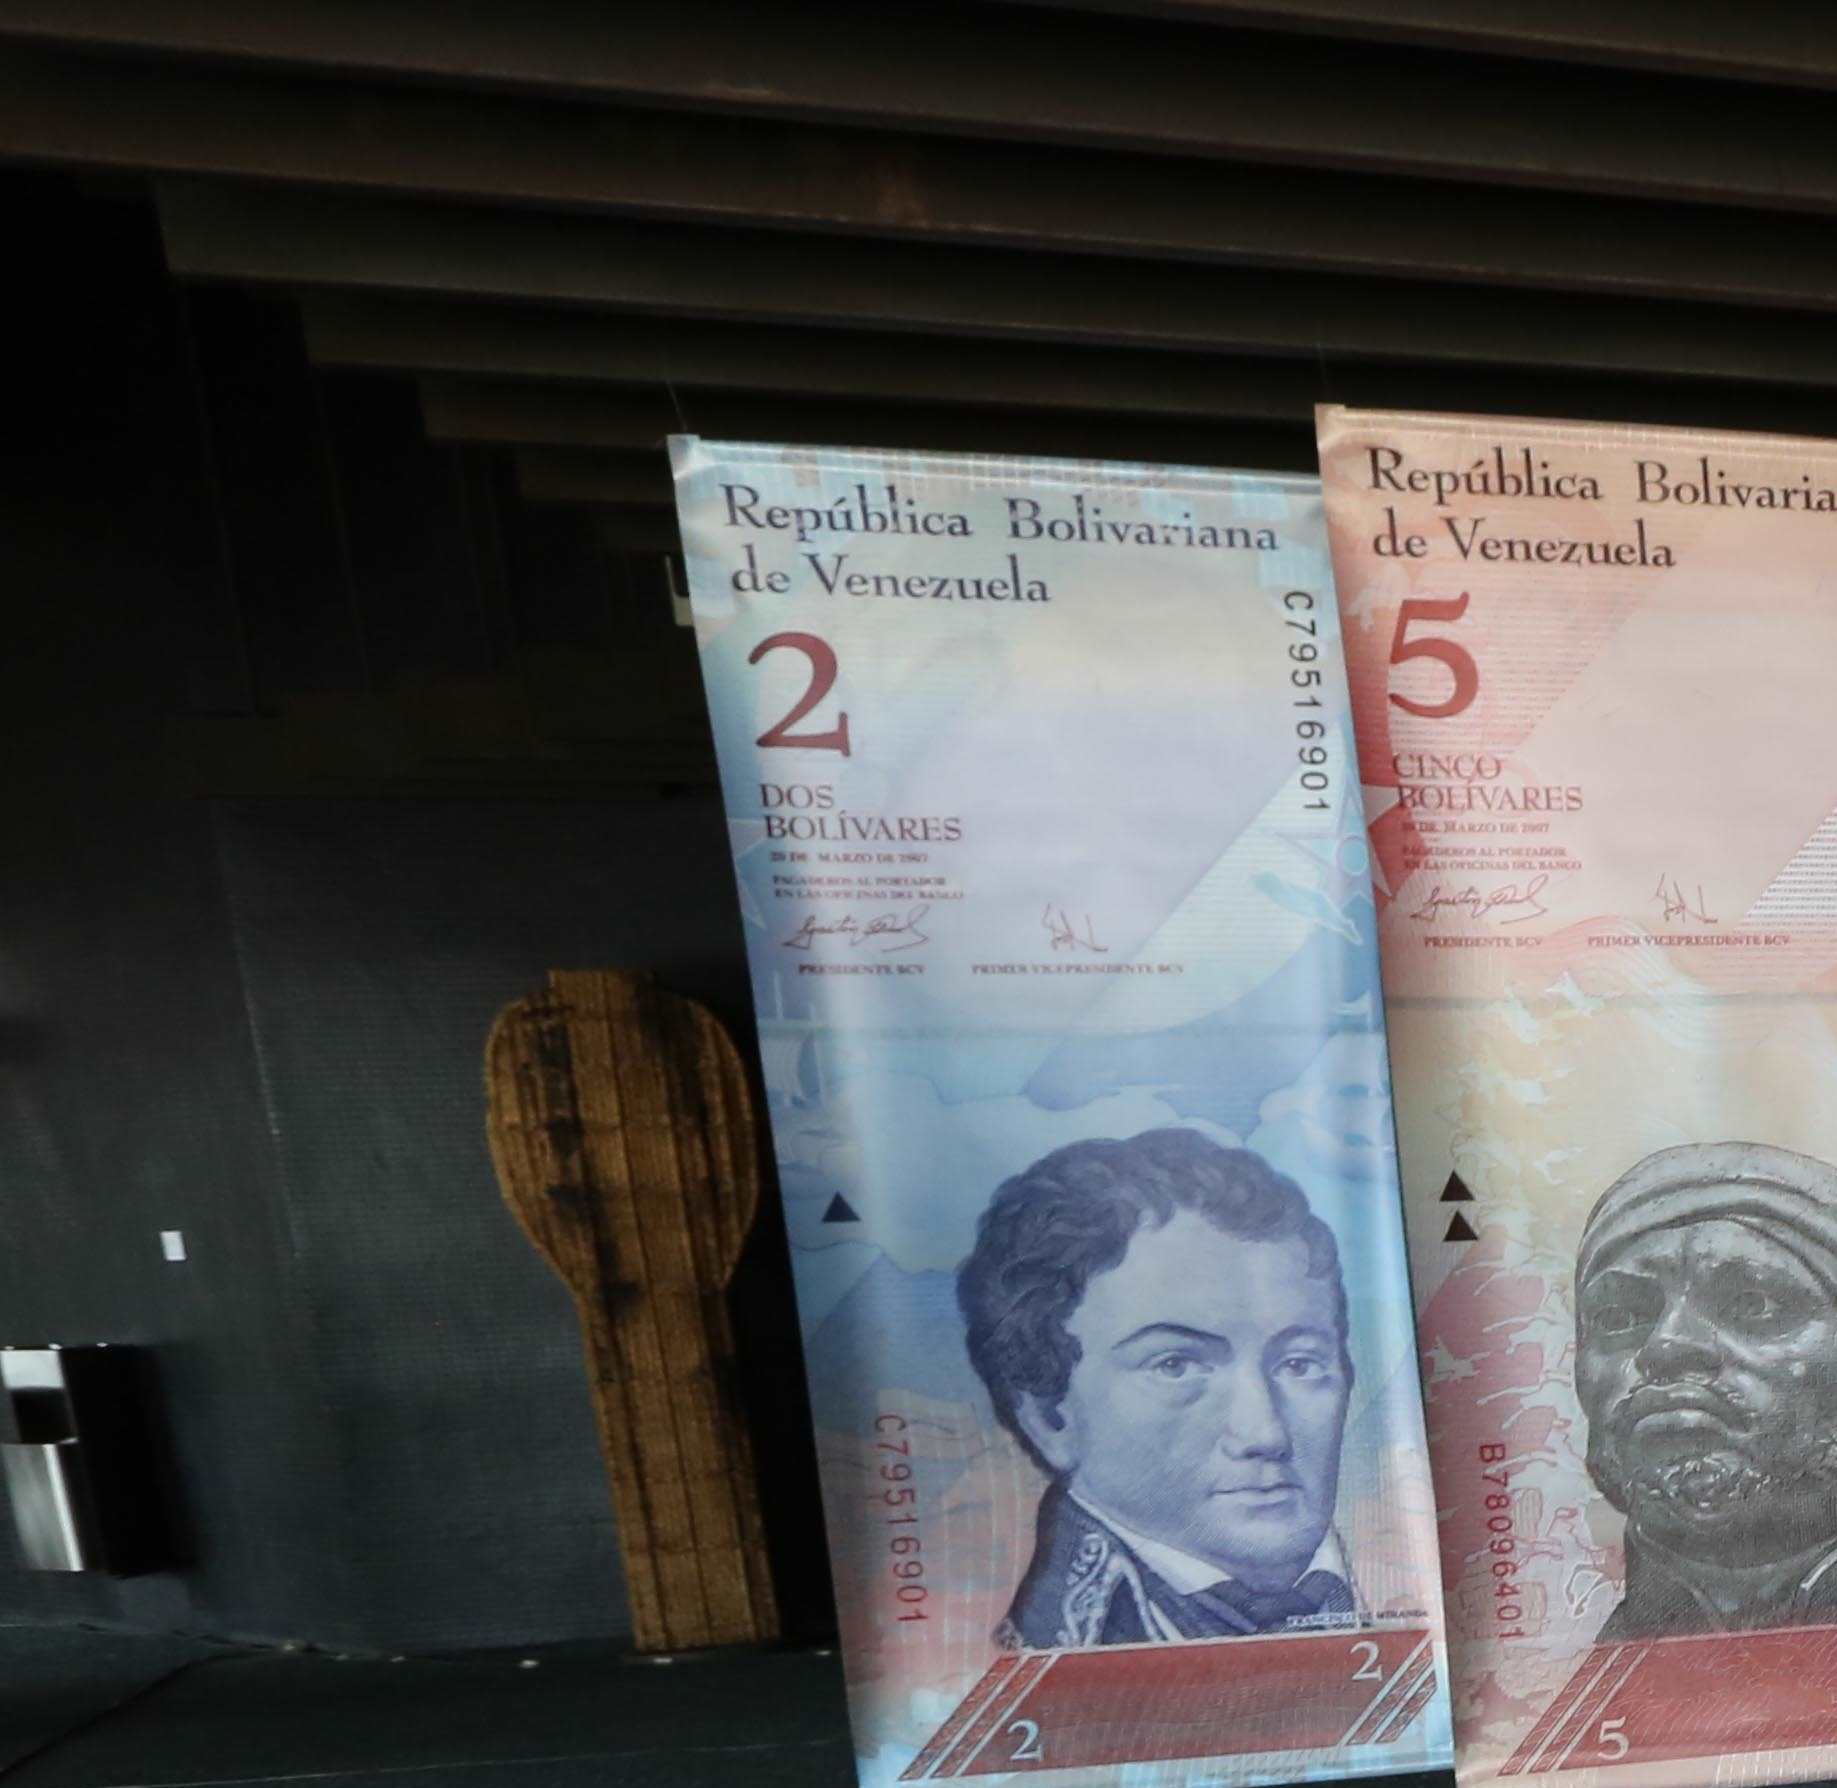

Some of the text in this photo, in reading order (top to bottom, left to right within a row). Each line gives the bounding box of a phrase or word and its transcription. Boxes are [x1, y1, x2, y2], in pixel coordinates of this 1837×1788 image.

[1366, 446, 1603, 503] República
[718, 483, 1280, 552] República Bolivariana
[1373, 507, 1676, 569] de Venezuela
[731, 545, 1051, 603] de Venezuela
[1389, 591, 1479, 719] 5
[747, 631, 852, 758] 2
[1283, 589, 1330, 812] C79516901
[1392, 753, 1502, 780] CINCO
[759, 783, 834, 809] DOS
[1397, 781, 1584, 812] BOLÍVARES
[764, 809, 962, 842] BOLÍVARES
[875, 1414, 929, 1624] C79516901
[1478, 1443, 1521, 1640] B78096401
[1350, 1640, 1383, 1682] 2
[1008, 1720, 1044, 1760] 2
[1598, 1718, 1630, 1761] 5
